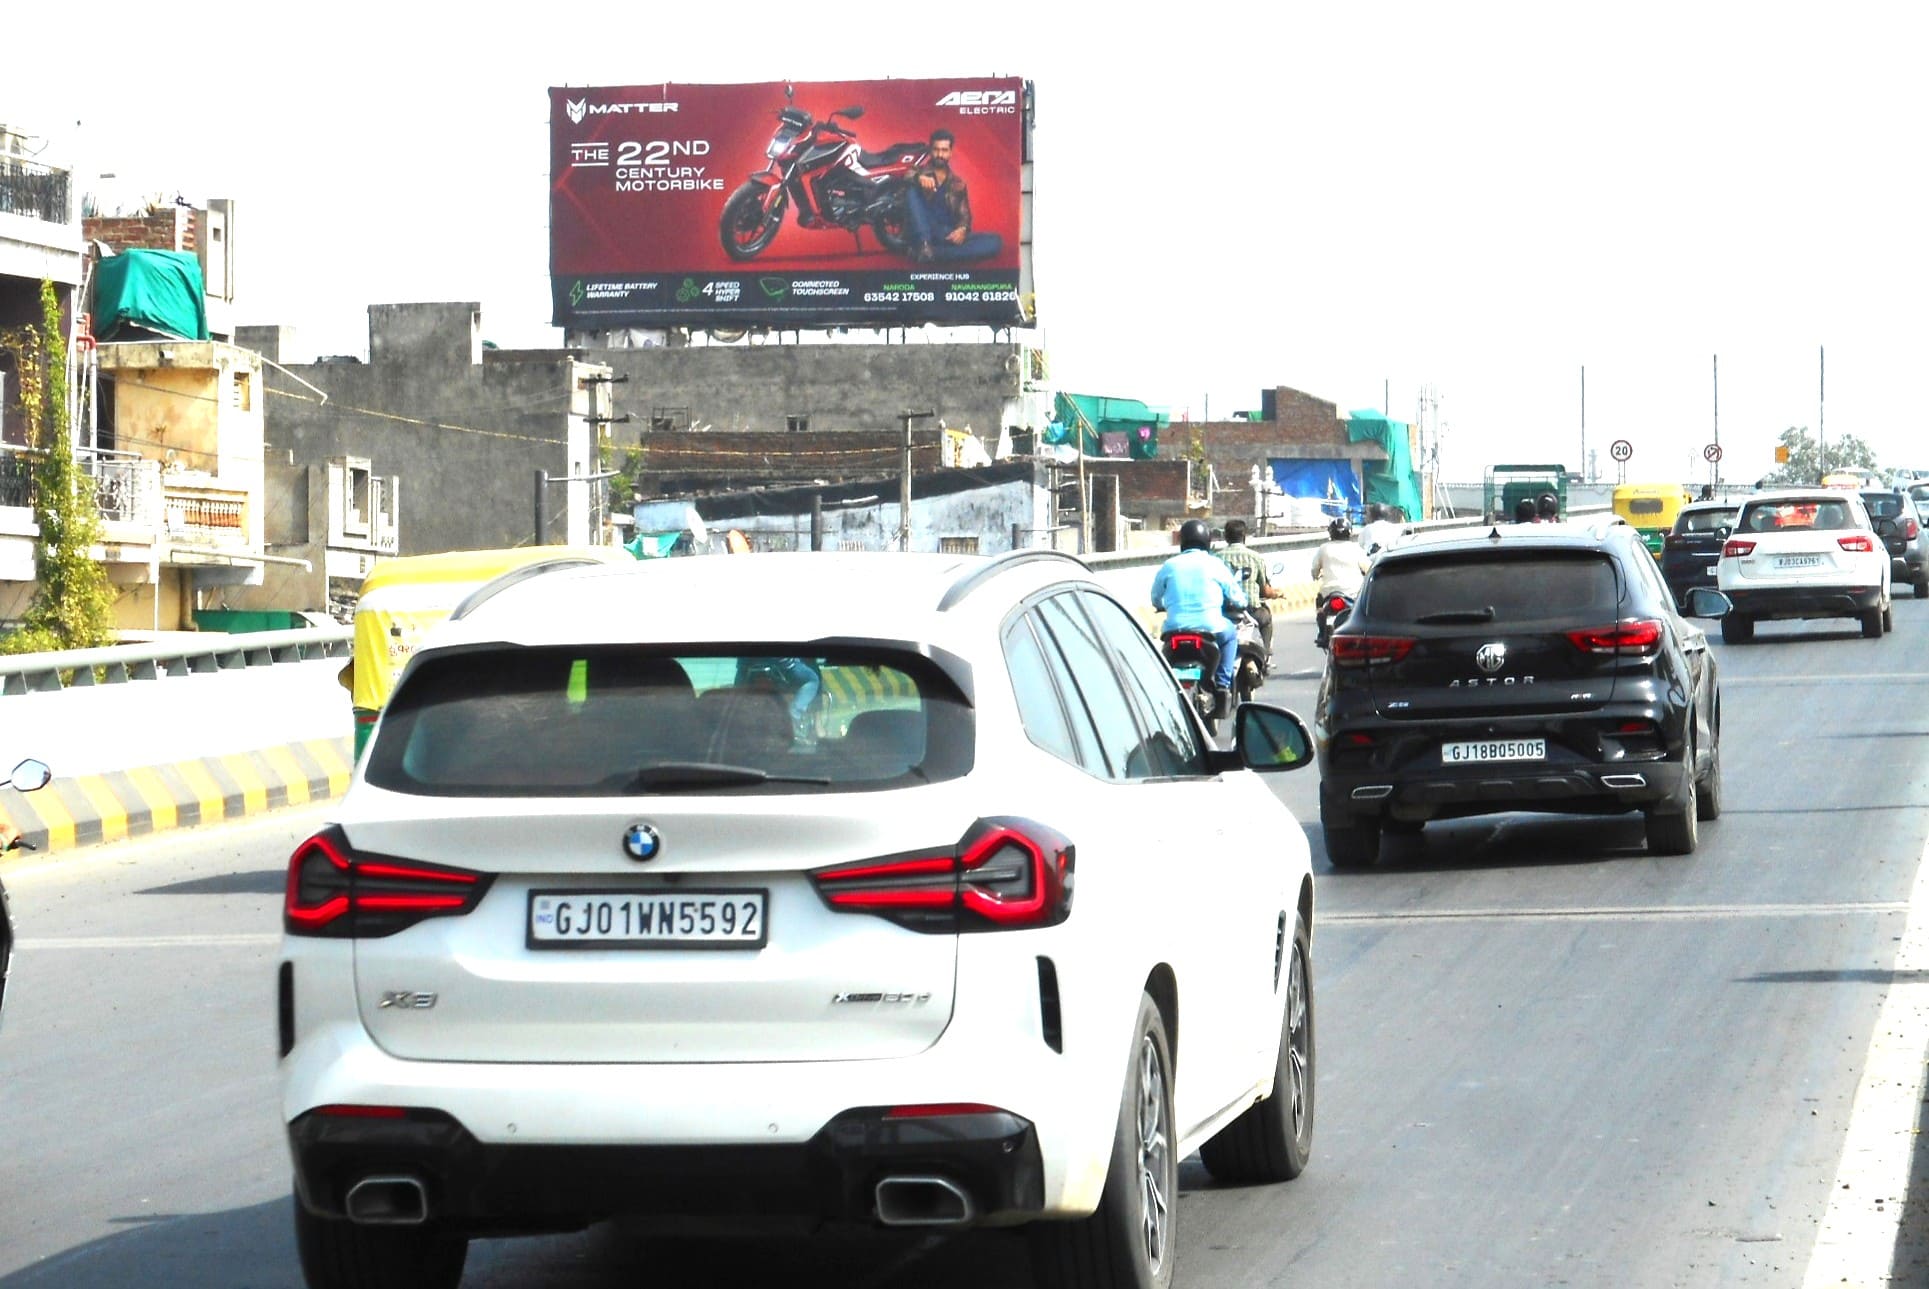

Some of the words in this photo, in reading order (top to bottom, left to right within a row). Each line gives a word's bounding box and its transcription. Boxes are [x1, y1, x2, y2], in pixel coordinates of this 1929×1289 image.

[589, 102, 679, 115] MATTER
[959, 106, 1016, 115] ELECTRIC
[571, 149, 610, 161] THE
[615, 167, 705, 179] CENTURY
[615, 179, 725, 192] MOTORBIKE
[910, 273, 954, 281] EXPERIENCE
[586, 283, 624, 291] LIFETIME
[624, 282, 658, 290] BATTERY
[702, 281, 714, 296] 4
[586, 291, 630, 299] WARRANTY
[864, 292, 900, 302] 63542
[901, 292, 935, 302] 17508
[945, 292, 980, 302] 91042
[1615, 445, 1628, 456] 20
[1449, 675, 1535, 688] ASTOR
[556, 901, 758, 935] GJ01WN5592
